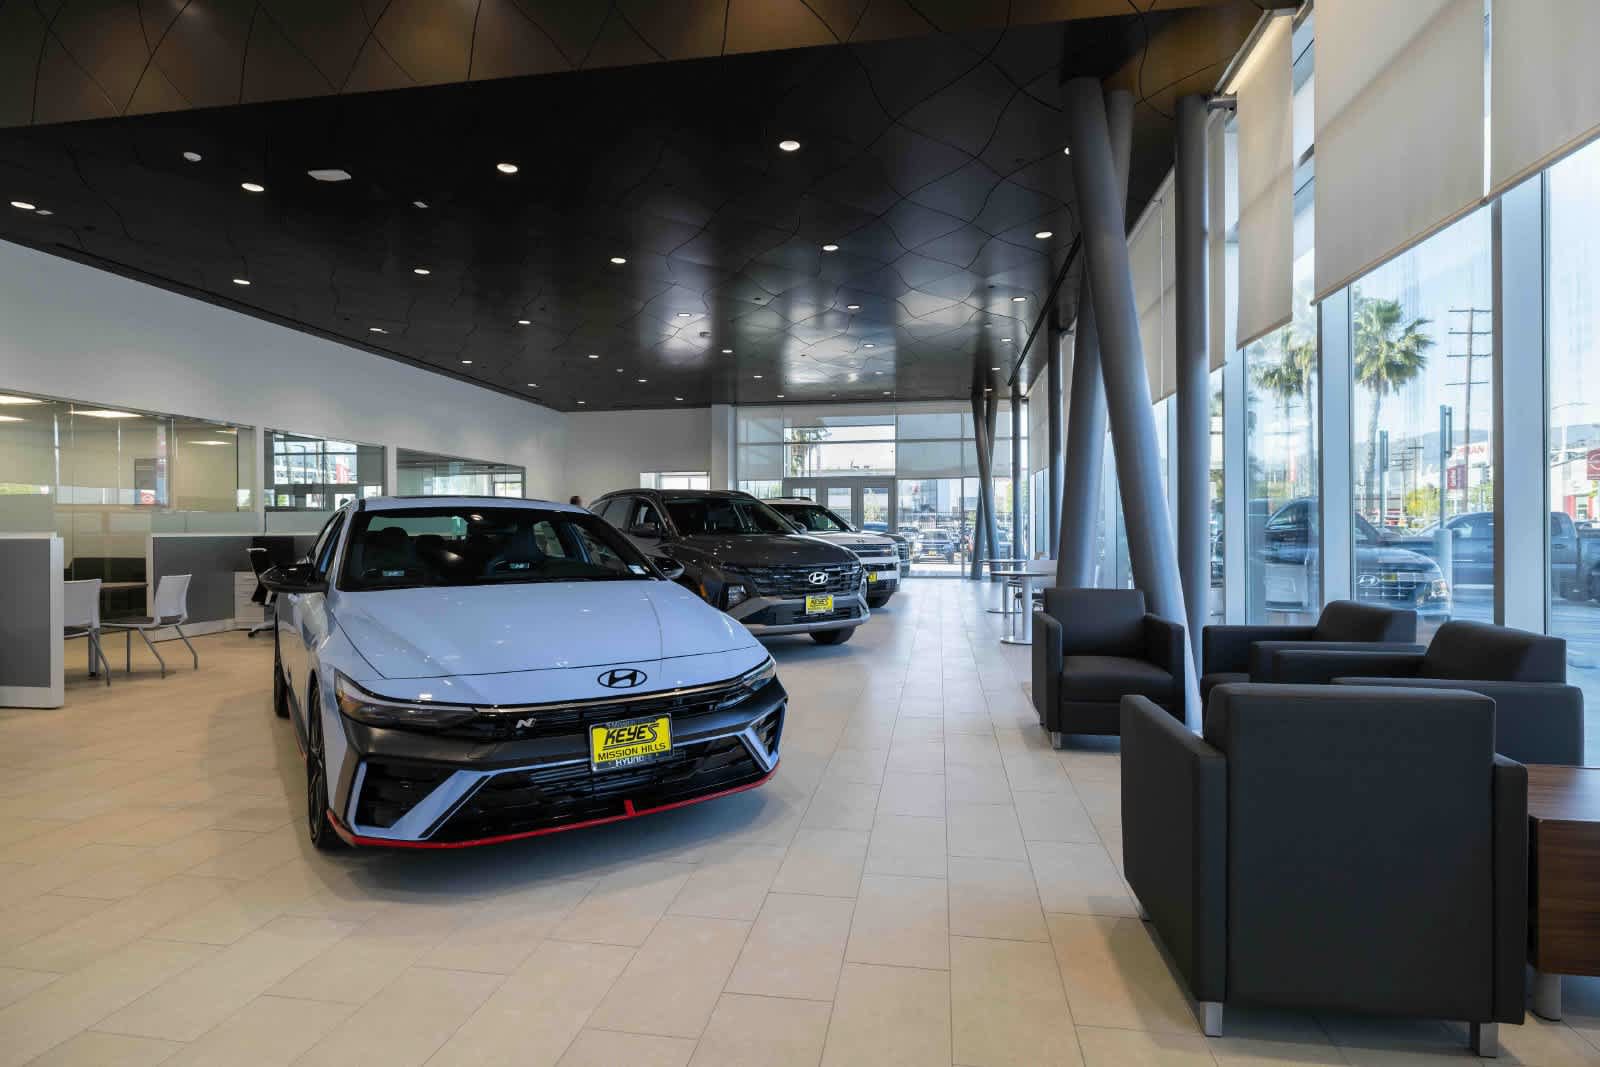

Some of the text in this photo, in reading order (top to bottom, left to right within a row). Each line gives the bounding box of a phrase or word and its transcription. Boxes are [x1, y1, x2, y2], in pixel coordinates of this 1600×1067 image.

[604, 723, 659, 747] KEYES
[598, 742, 666, 761] MISSION HILLS
